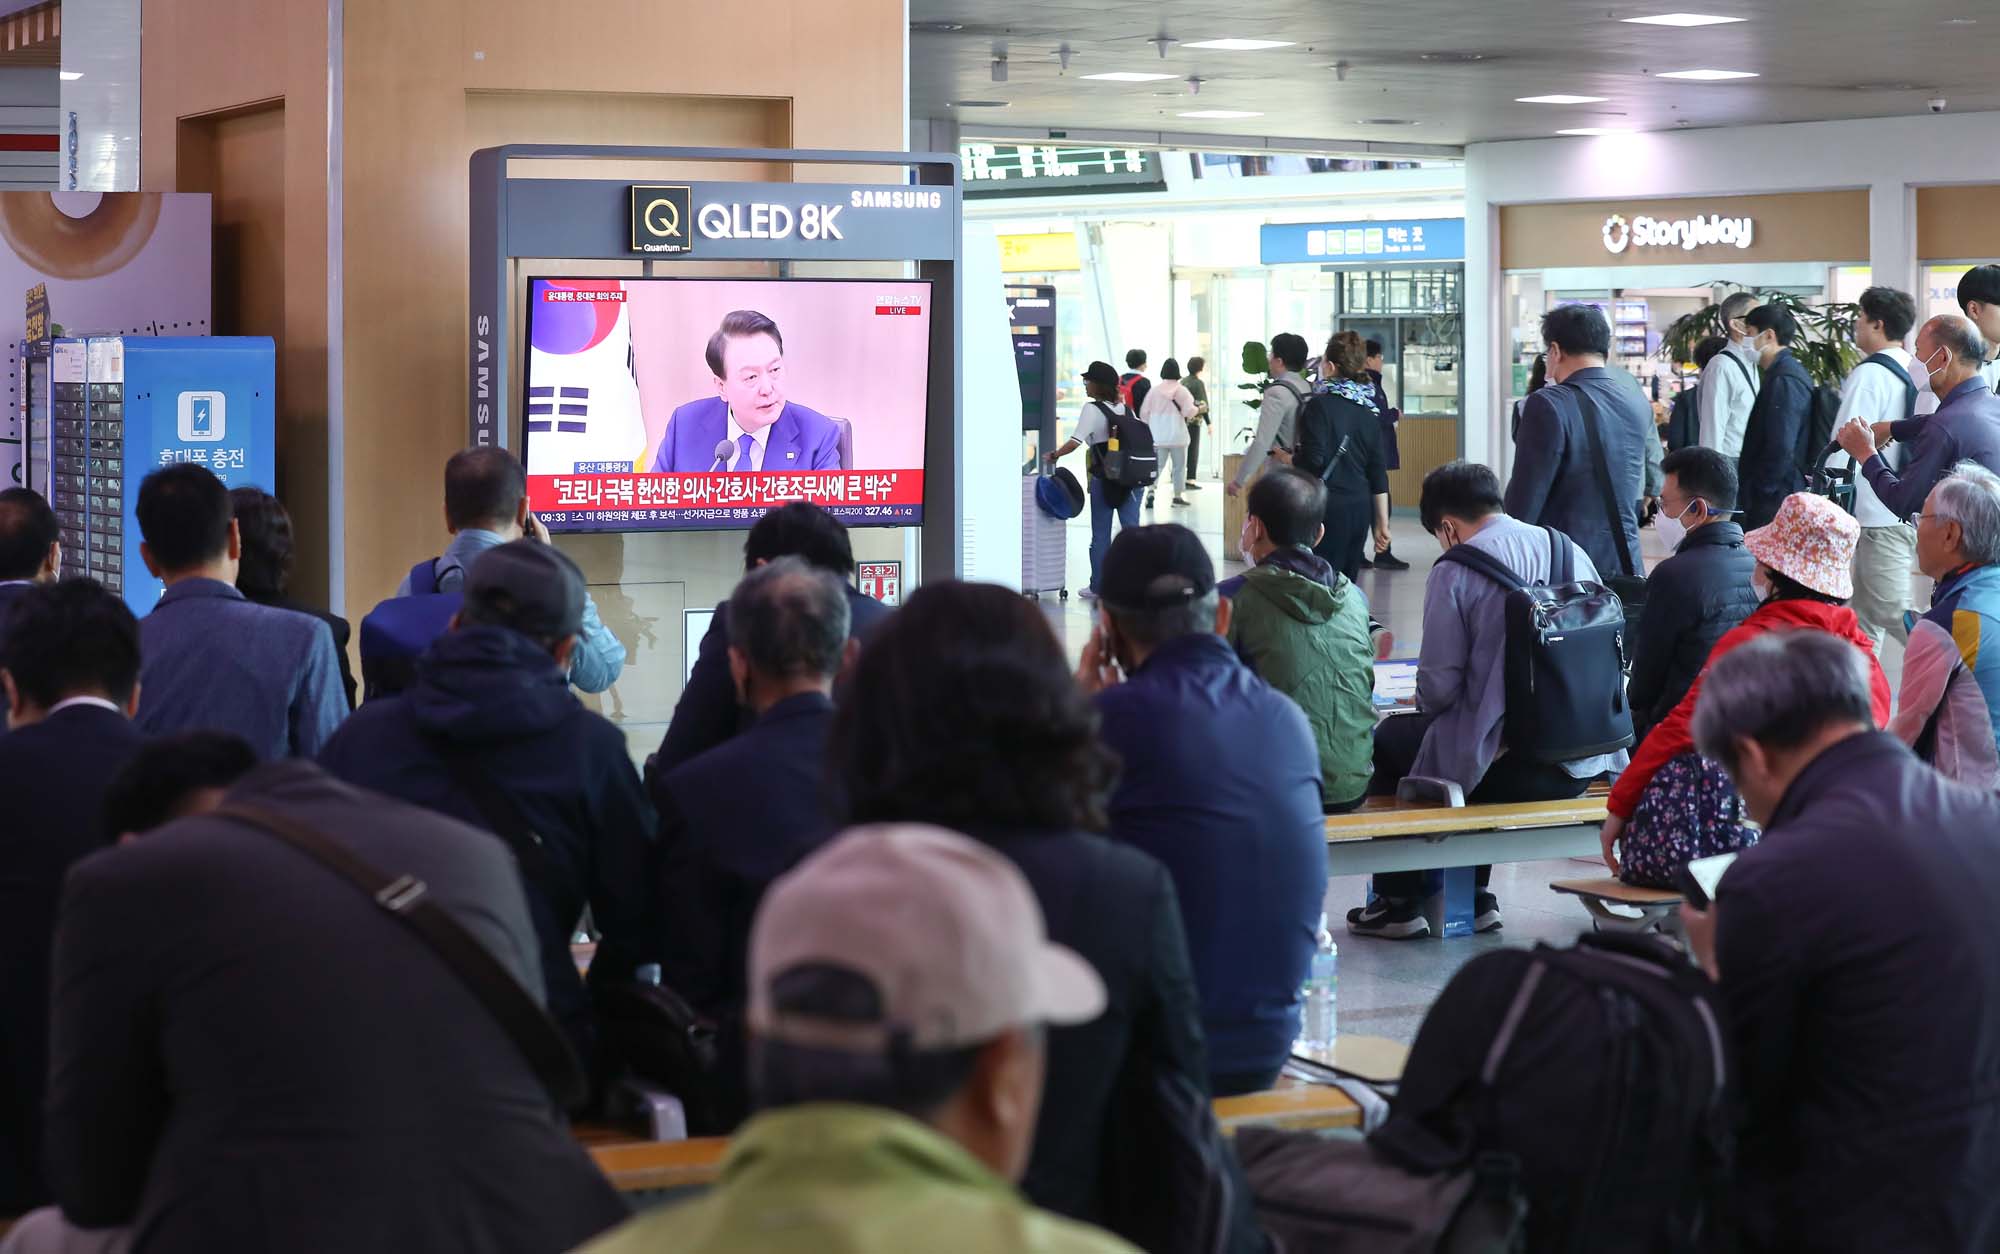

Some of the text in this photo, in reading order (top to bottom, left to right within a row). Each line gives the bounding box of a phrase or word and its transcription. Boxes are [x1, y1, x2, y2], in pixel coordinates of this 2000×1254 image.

[851, 190, 942, 209] SAMSUNG
[644, 198, 681, 237] Q
[697, 202, 844, 240] QLED 8K
[1632, 214, 1752, 250] StoryWay
[643, 242, 681, 253] Quantum
[890, 306, 906, 315] LIVE
[477, 315, 489, 447] SAMSU
[211, 448, 244, 469] 충전
[578, 461, 629, 474] 용산 대통령실
[553, 478, 603, 506] "코로나
[604, 478, 634, 506] 극복
[637, 477, 681, 505] 헌신한
[847, 475, 862, 501] 큰
[864, 473, 897, 502] 박수"
[540, 512, 566, 522] 09:33
[586, 511, 595, 522] 미
[596, 510, 629, 522] 하원의원
[630, 510, 647, 521] 체포
[649, 510, 658, 521] 후
[733, 507, 749, 519] 명품
[750, 507, 767, 519] 쇼핑
[833, 506, 913, 516] 코스피200 327.46 1.42
[863, 565, 896, 576] 소화기
